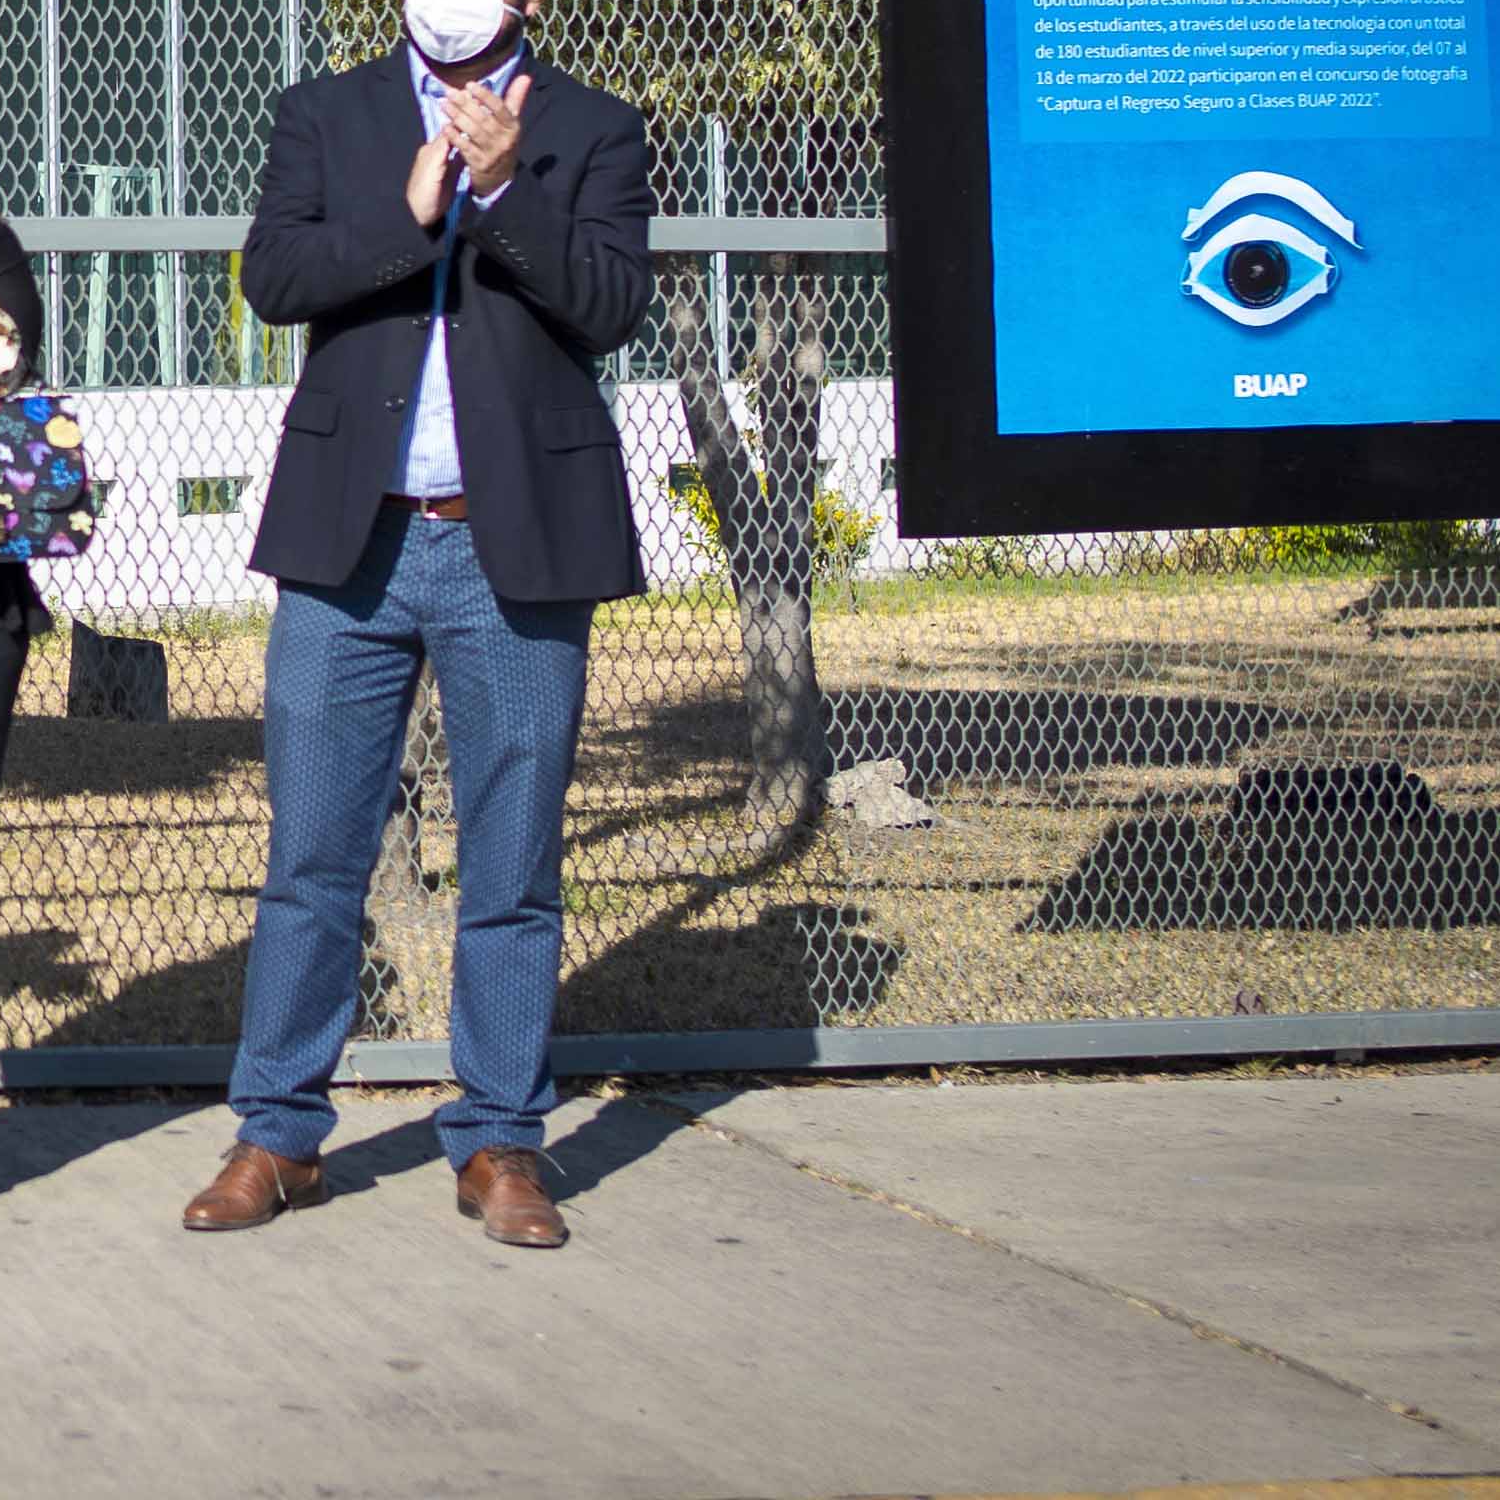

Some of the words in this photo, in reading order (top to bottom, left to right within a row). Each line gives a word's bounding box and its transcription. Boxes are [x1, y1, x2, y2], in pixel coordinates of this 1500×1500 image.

[1035, 19, 1053, 33] de
[1055, 18, 1076, 33] los
[1078, 18, 1166, 35] estudiantes,
[1169, 21, 1177, 32] a
[1180, 17, 1223, 32] través
[1226, 17, 1247, 31] del
[1252, 20, 1275, 31] uso
[1278, 17, 1295, 31] de
[1298, 17, 1310, 31] la
[1388, 19, 1411, 30] con
[1415, 19, 1432, 30] un
[1435, 15, 1465, 30] total
[1036, 45, 1053, 59] de
[1057, 44, 1082, 59] 180
[1085, 44, 1169, 58] estudiantes
[1172, 43, 1190, 58] de
[1193, 43, 1226, 57] nivel
[1231, 43, 1289, 60] superior
[1292, 46, 1299, 60] y
[1303, 42, 1346, 56] media
[1413, 41, 1432, 55] del
[1455, 41, 1466, 55] al
[1037, 71, 1052, 85] 18
[1056, 70, 1073, 85] de
[1078, 73, 1122, 84] marzo
[1125, 70, 1147, 84] del
[1152, 69, 1185, 84] 2022
[1189, 69, 1276, 86] participaron
[1280, 71, 1296, 82] en
[1300, 68, 1312, 82] el
[1316, 71, 1379, 82] concurso
[1382, 67, 1398, 81] de
[1106, 95, 1117, 110] el
[1122, 95, 1179, 112] Regreso
[1184, 94, 1233, 112] Seguro
[1238, 97, 1246, 108] a
[1249, 93, 1295, 108] Clases
[1298, 93, 1336, 107] BUAP
[1233, 373, 1308, 398] BUAP
